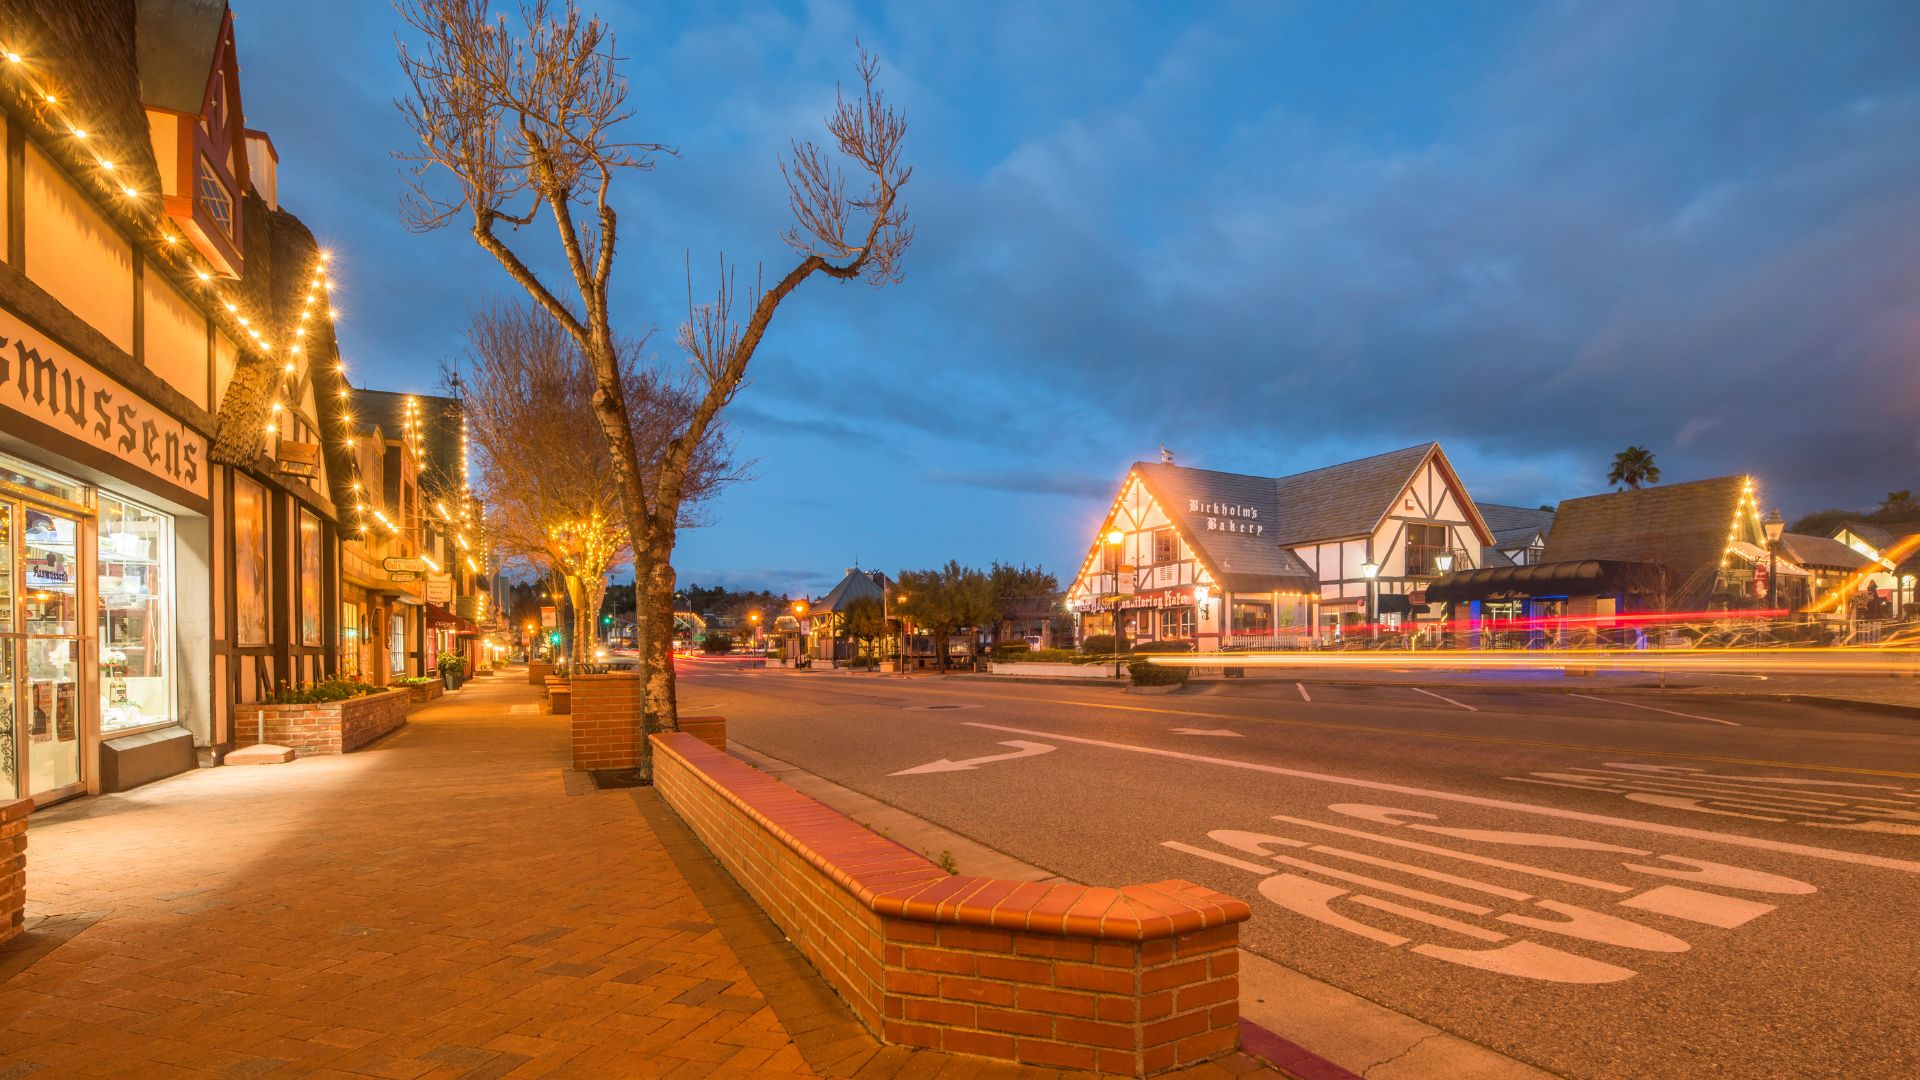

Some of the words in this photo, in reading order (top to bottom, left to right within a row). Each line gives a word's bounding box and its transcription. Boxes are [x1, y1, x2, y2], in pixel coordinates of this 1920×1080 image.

[1188, 499, 1258, 519] Birkholm's
[1207, 517, 1263, 537] Bakery
[1160, 802, 1819, 984] STOP
